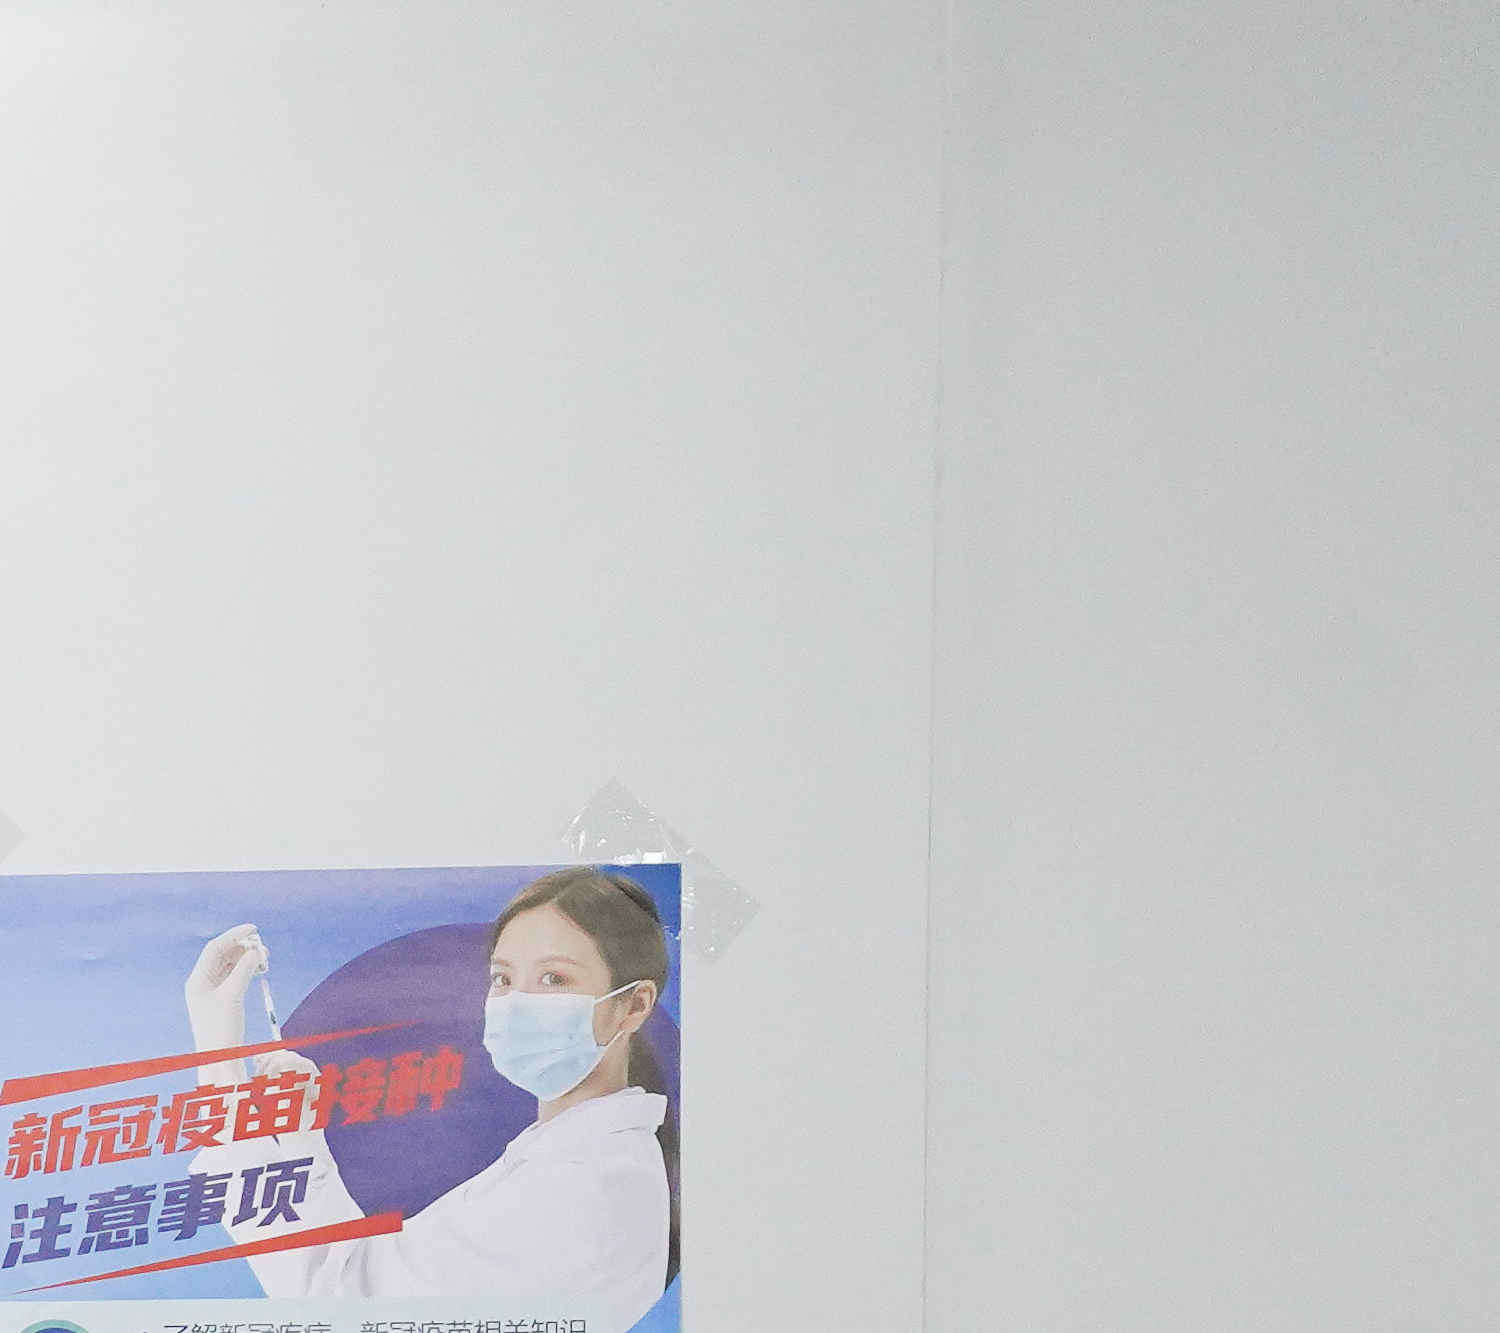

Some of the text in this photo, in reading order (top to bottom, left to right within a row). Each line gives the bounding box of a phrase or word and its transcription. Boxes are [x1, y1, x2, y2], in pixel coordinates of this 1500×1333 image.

[4, 1048, 466, 1181] 新冠疫苗接种
[1, 1157, 314, 1270] 注意事项
